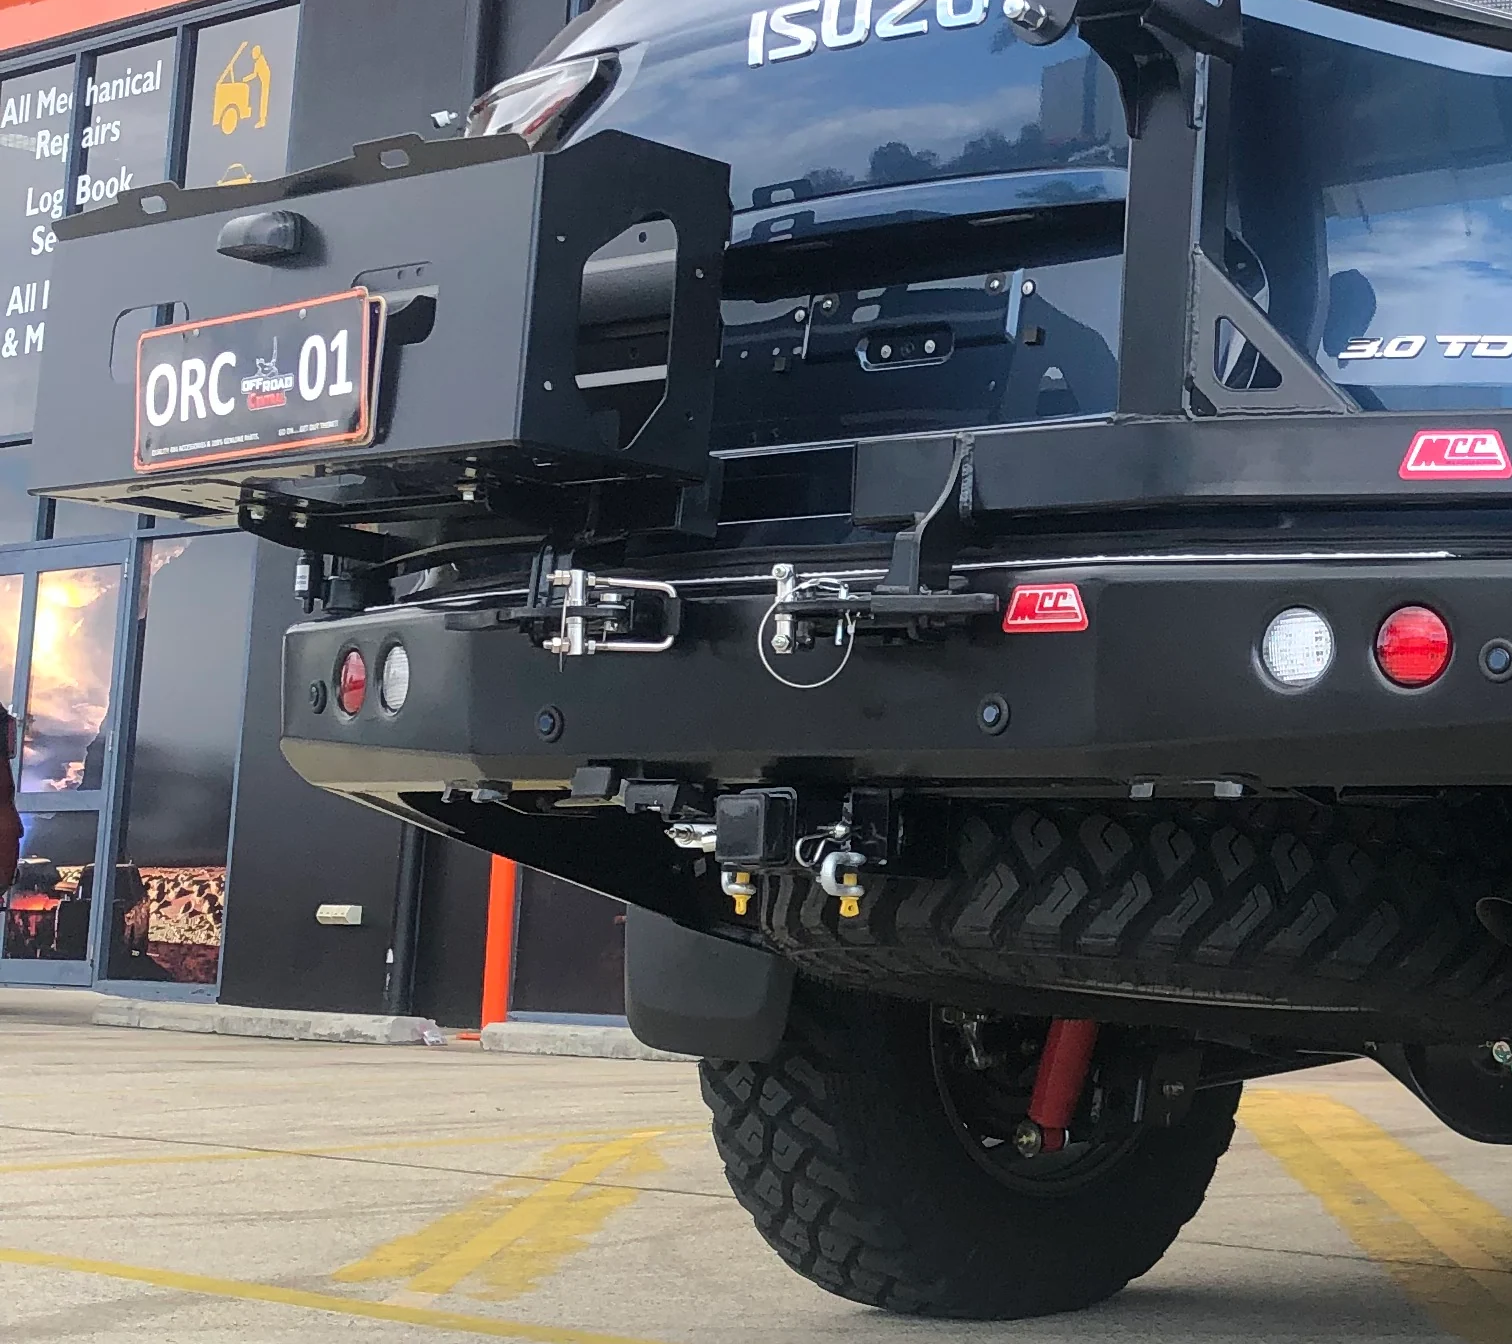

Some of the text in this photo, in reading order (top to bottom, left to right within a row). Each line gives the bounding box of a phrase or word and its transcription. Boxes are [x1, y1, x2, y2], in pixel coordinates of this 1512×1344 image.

[1, 93, 31, 128] All
[26, 166, 133, 218] Log Book
[6, 282, 37, 316] All
[2, 327, 18, 358] &
[1338, 335, 1427, 359] 3.0
[146, 329, 353, 426] ORC 01
